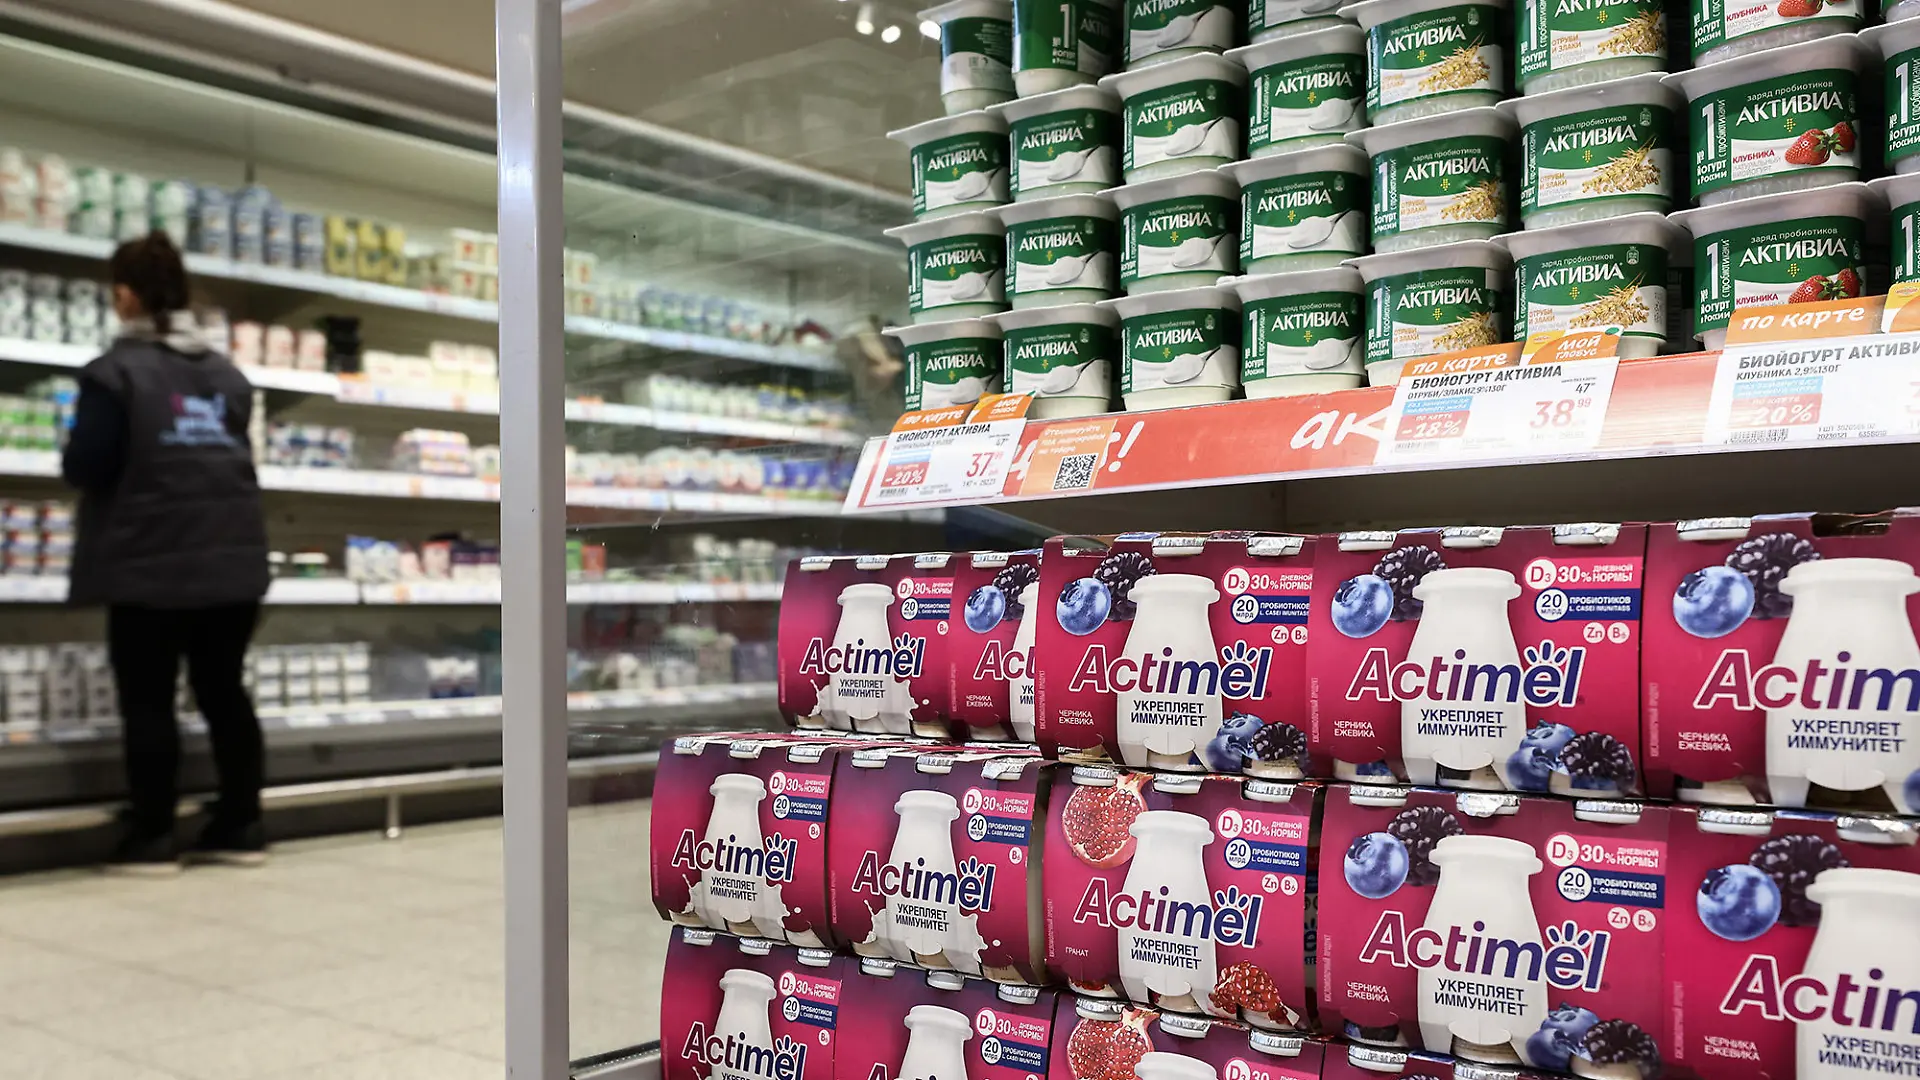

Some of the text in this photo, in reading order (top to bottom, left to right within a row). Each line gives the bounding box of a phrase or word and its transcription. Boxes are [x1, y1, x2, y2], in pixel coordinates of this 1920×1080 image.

[1555, 0, 1651, 18] АКТИВ
[1726, 4, 1768, 22] КЛУБНИКА
[1383, 24, 1466, 57] АКТИВИА
[1275, 72, 1353, 97] АКТИВИА
[1747, 81, 1833, 102] заряд пробиотиков
[1136, 99, 1206, 126] АКТИВИА
[1736, 92, 1843, 126] АКТИВИА
[1553, 115, 1627, 133] заряд пробиотиков
[1702, 103, 1715, 160] 1
[1021, 127, 1083, 150] АКТИВИА
[1543, 124, 1638, 155] АКТИВИА
[927, 149, 988, 171] АКТИВИА
[1733, 149, 1775, 164] КЛУБНИКА
[1403, 157, 1491, 183] АКТИВИА
[1697, 159, 1727, 176] йогурт
[1257, 189, 1333, 214] АКТИВИА
[1141, 212, 1212, 235] АКТИВИА
[1019, 231, 1083, 252] АКТИВИА
[1751, 227, 1838, 244] заряд пробиотиков
[924, 249, 986, 270] АКТИВИА
[1541, 253, 1614, 268] заряд пробиотиков
[1739, 238, 1849, 268] АКТИВИА
[1532, 262, 1625, 291] АКТИВИА
[1707, 242, 1719, 300] 1
[1397, 287, 1482, 311] АКТИВИА
[1700, 300, 1730, 314] йогурт
[1736, 293, 1779, 305] КЛУБНИКА
[1271, 311, 1349, 332] АКТИВИА
[1742, 307, 1866, 331] по карте
[1135, 327, 1204, 349] АКТИВИА
[1015, 340, 1079, 360] АКТИВИА
[1739, 347, 1845, 370] БИОЙОГУРТ
[925, 353, 985, 372] АКТИВИА
[1412, 351, 1507, 374] по карте
[1411, 365, 1562, 390] БИОЙОГУРТ АКТИВИА
[1736, 369, 1792, 381] КЛУБНИКА
[1575, 384, 1591, 394] 47
[922, 409, 964, 424] карте
[1529, 398, 1575, 430] 38
[896, 424, 991, 443] БИОЙОГУРТ АКТИВИА
[1401, 419, 1462, 438] -18%
[966, 452, 995, 478] 37
[886, 469, 924, 486] -20%
[1279, 581, 1313, 590] НОРМЫ
[1280, 573, 1313, 581] ДНЕВНОЙ
[1592, 572, 1633, 582] НОРМЫ
[1236, 599, 1255, 612] 20
[1542, 594, 1562, 608] 20
[1569, 596, 1632, 605] ПРОБИОТИКОВ
[1274, 629, 1287, 640] Zn
[1587, 626, 1603, 638] Zn
[799, 632, 927, 678] Actimel
[1068, 639, 1274, 701] Actimel
[1345, 639, 1587, 708] Actimel
[839, 679, 884, 689] УКРЕПЛЯЕТ
[837, 687, 886, 699] ИММУНИТЕТ
[965, 695, 992, 703] ЧЕРНИКА
[965, 701, 994, 709] ЕЖЕВИКА
[1133, 700, 1204, 715] УКРЕПЛЯЕТ
[1058, 709, 1093, 719] ЧЕРНИКА
[1058, 716, 1094, 726] ЕЖЕВИКА
[1130, 712, 1208, 727] ИММУНИТЕТ
[1420, 708, 1504, 724] УКРЕПЛЯЕТ
[1333, 721, 1373, 730] ЧЕРНИКА
[1333, 728, 1375, 738] ЕЖЕВИКА
[1417, 722, 1506, 738] ИММУНИТЕТ
[1791, 718, 1902, 737] УКРЕПЛЯЕТ
[1678, 732, 1729, 742] ЧЕРНИКА
[1787, 735, 1905, 753] ИММУНИТЕТ
[1678, 740, 1732, 752] ЕЖЕВИКА
[970, 818, 984, 831] 20
[1272, 821, 1303, 830] ДНЕВНОЙ
[1270, 828, 1302, 839] НОРМЫ
[671, 829, 798, 883] Actimel
[1229, 843, 1247, 857] 20
[1251, 848, 1300, 860] ПРОБИОТИКОВ
[1616, 855, 1659, 868] НОРМЫ
[711, 876, 756, 892] УКРЕПЛЯЕТ
[852, 850, 997, 912] Actimel
[1264, 877, 1278, 889] Zn
[1563, 872, 1586, 888] 20
[1593, 878, 1658, 891] ПРОБИОТИКОВ
[709, 886, 758, 902] ИММУНИТЕТ
[897, 903, 948, 921] УКРЕПЛЯЕТ
[1073, 878, 1264, 949] Actimel
[1611, 911, 1628, 924] Zn
[895, 914, 950, 932] ИММУНИТЕТ
[1065, 946, 1089, 957] ГРАНАТ
[1132, 936, 1199, 957] УКРЕПЛЯЕТ
[1359, 910, 1611, 993] Actimel
[1130, 949, 1202, 970] ИММУНИТЕТ
[1346, 981, 1388, 994] ЧЕРНИКА
[1437, 978, 1525, 1001] УКРЕПЛЯЕТ
[1346, 990, 1390, 1003] ЕЖЕВИКА
[1434, 992, 1529, 1016] ИММУНИТЕТ
[785, 999, 797, 1012] 20
[1018, 1030, 1044, 1041] НОРМЫ
[1704, 1035, 1757, 1050] ЧЕРНИКА
[682, 1021, 808, 1080] Actimel
[984, 1040, 999, 1054] 20
[1704, 1044, 1760, 1061] ЕЖЕВИКА
